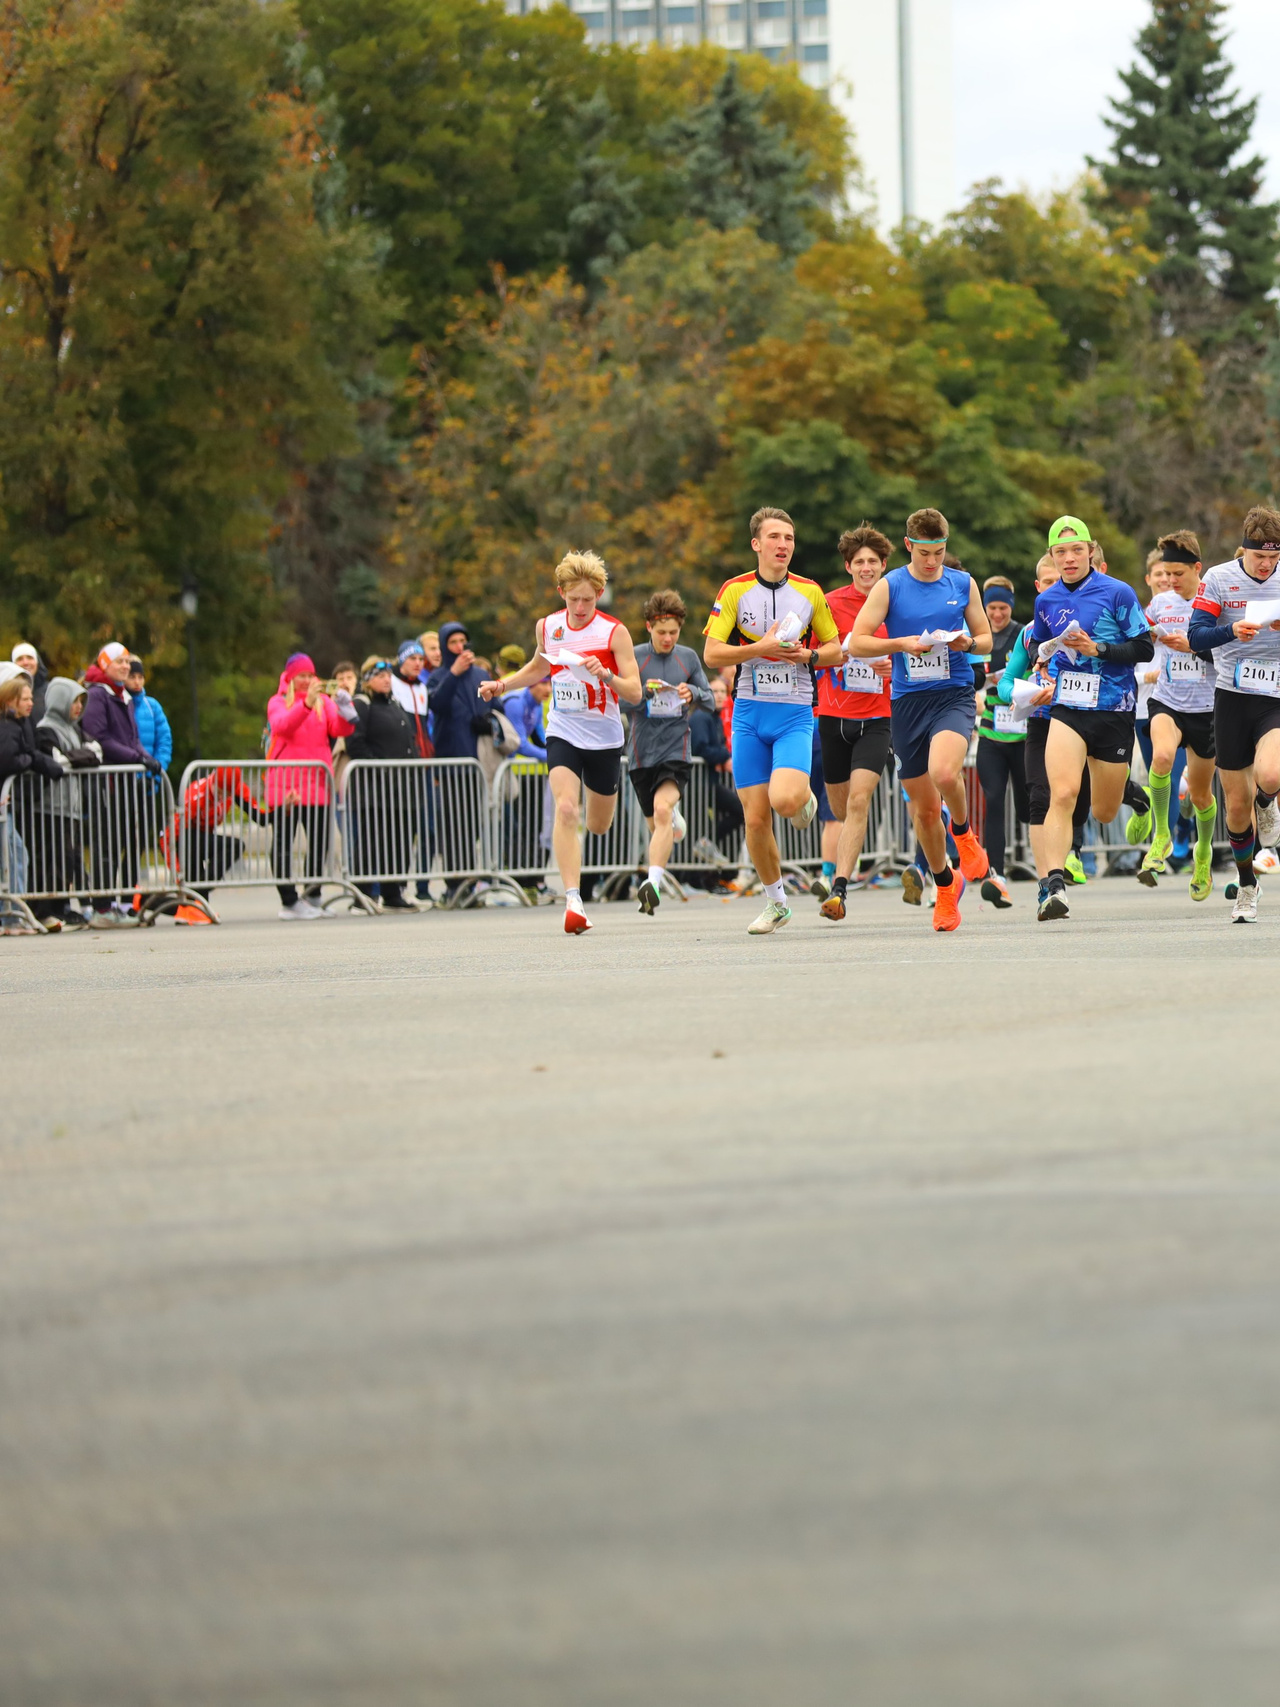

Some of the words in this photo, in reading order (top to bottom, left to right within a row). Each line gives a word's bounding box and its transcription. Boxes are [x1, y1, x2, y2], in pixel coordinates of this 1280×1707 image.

[1223, 600, 1247, 608] NOR
[1159, 616, 1185, 624] NORD
[1171, 660, 1200, 671] 216.1
[758, 673, 790, 684] 236.1
[848, 667, 876, 679] 232.1
[1242, 667, 1276, 681] 210.1
[1062, 678, 1091, 692] 219.1
[556, 690, 581, 701] 229.1
[996, 713, 1015, 722] 227.
